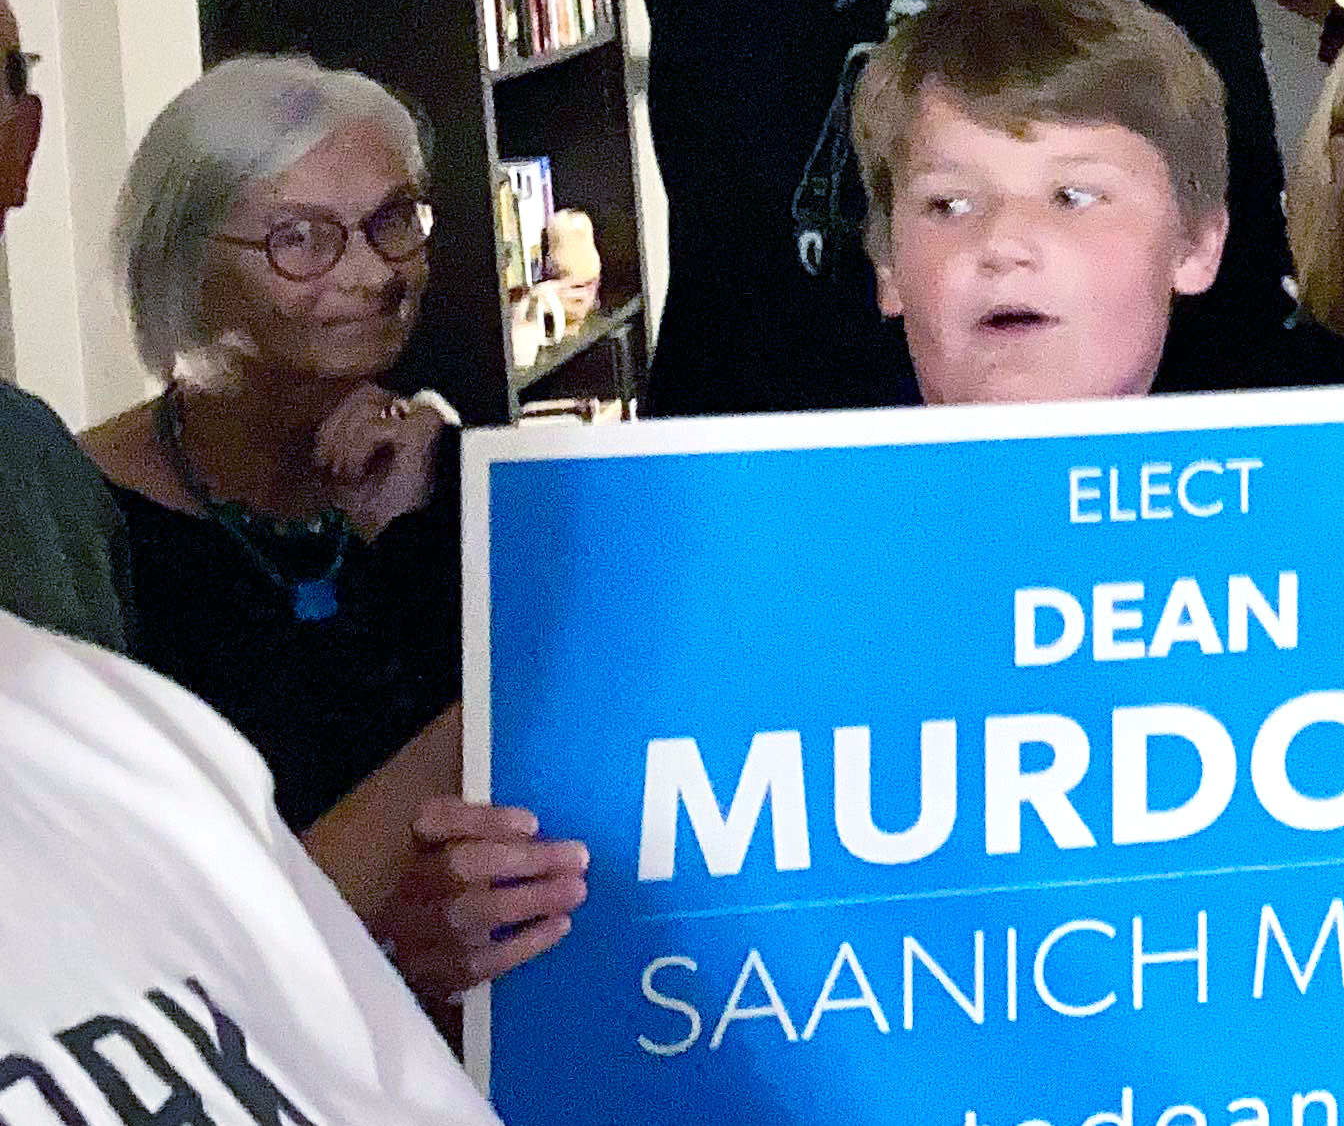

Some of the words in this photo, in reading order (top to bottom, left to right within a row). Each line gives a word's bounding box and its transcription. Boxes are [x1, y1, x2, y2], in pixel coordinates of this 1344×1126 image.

[1069, 458, 1264, 524] ELECT
[1014, 571, 1299, 667] DEAN
[638, 911, 1208, 1054] SAANICH
